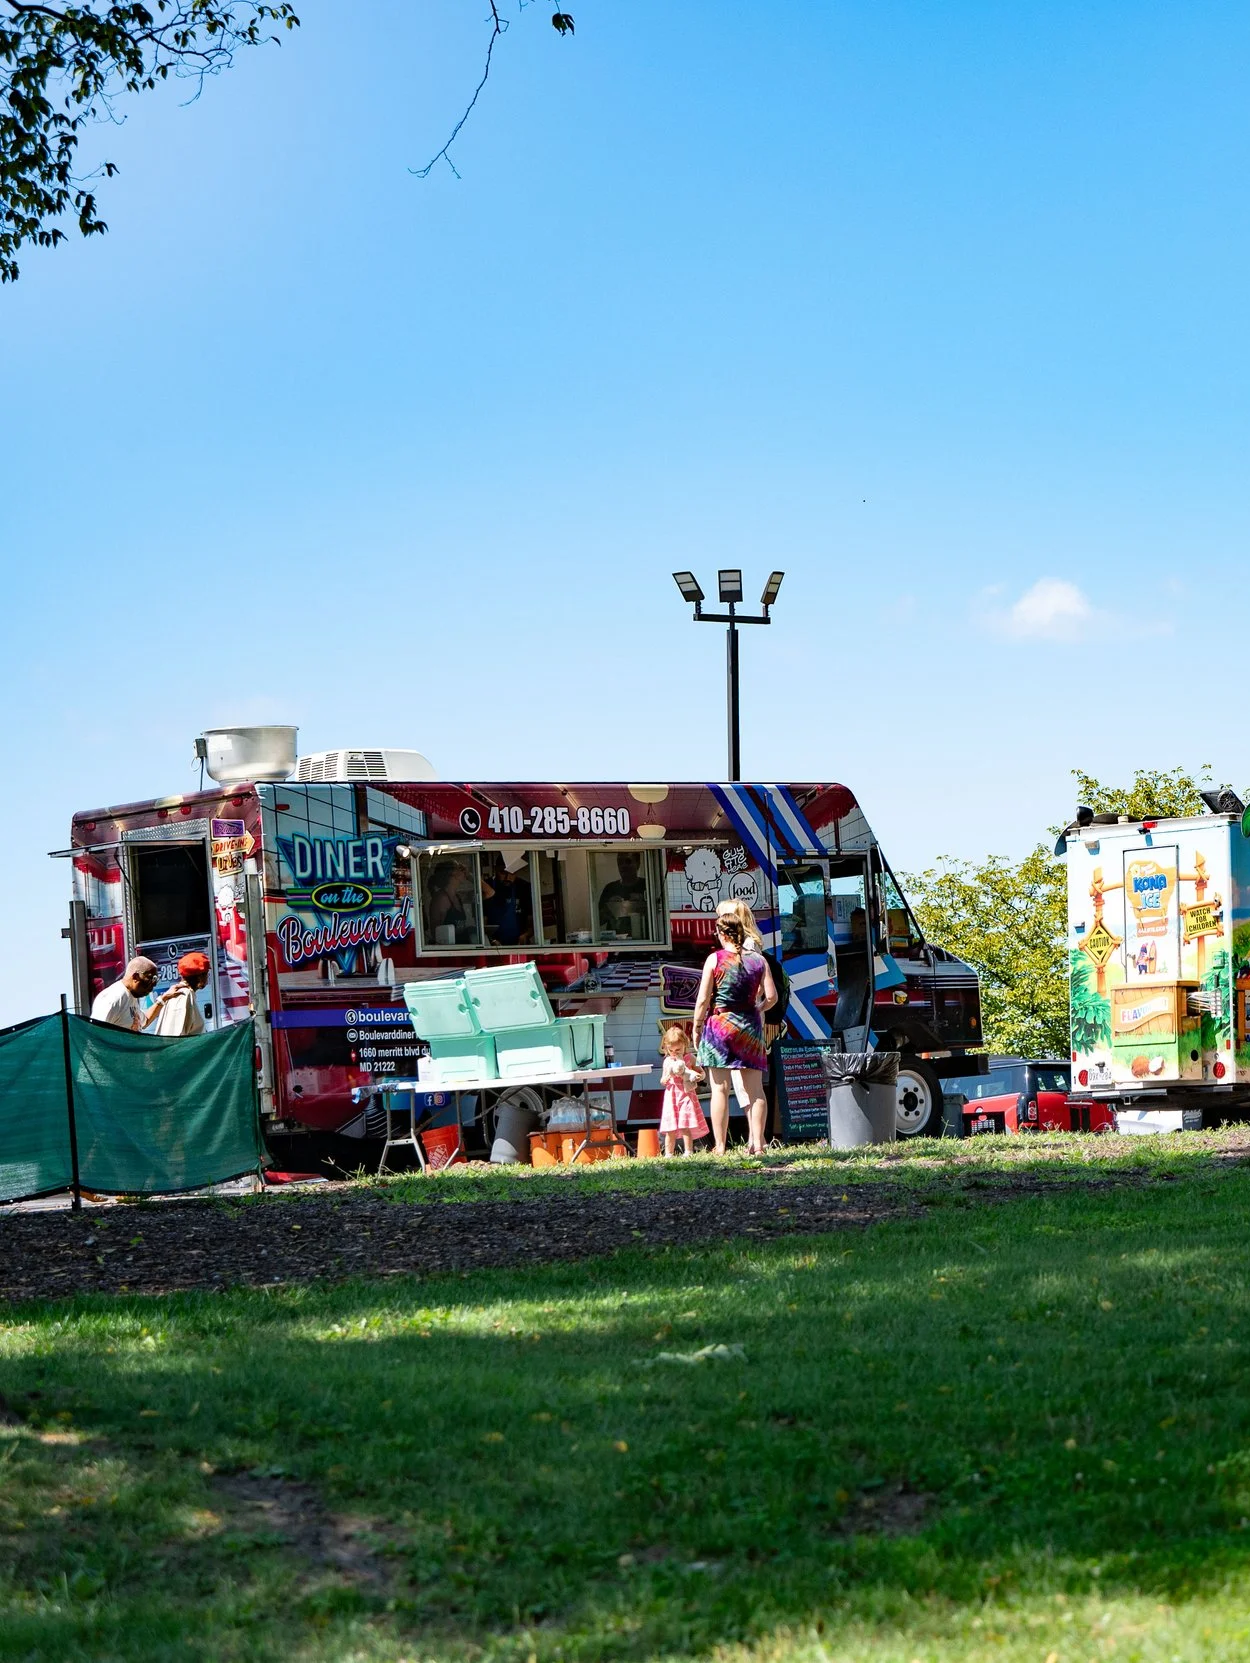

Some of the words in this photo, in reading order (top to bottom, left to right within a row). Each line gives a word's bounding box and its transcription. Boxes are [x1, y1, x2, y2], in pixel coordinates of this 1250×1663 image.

[488, 805, 630, 835] 410-285-8660
[292, 835, 386, 879] DINER
[733, 882, 756, 898] food
[1133, 874, 1167, 893] KONA
[320, 893, 339, 904] on
[341, 887, 364, 904] the
[1140, 892, 1161, 909] ICE
[1189, 907, 1211, 918] WATCH
[277, 895, 411, 964] Boulevard
[1189, 919, 1217, 932] CHILDREN
[1090, 936, 1110, 949] CAUTION
[359, 1047, 376, 1058] 1660
[378, 1047, 403, 1057] merritt
[404, 1046, 420, 1056] blvd
[360, 1063, 372, 1072] MD
[373, 1061, 396, 1072] 21222
